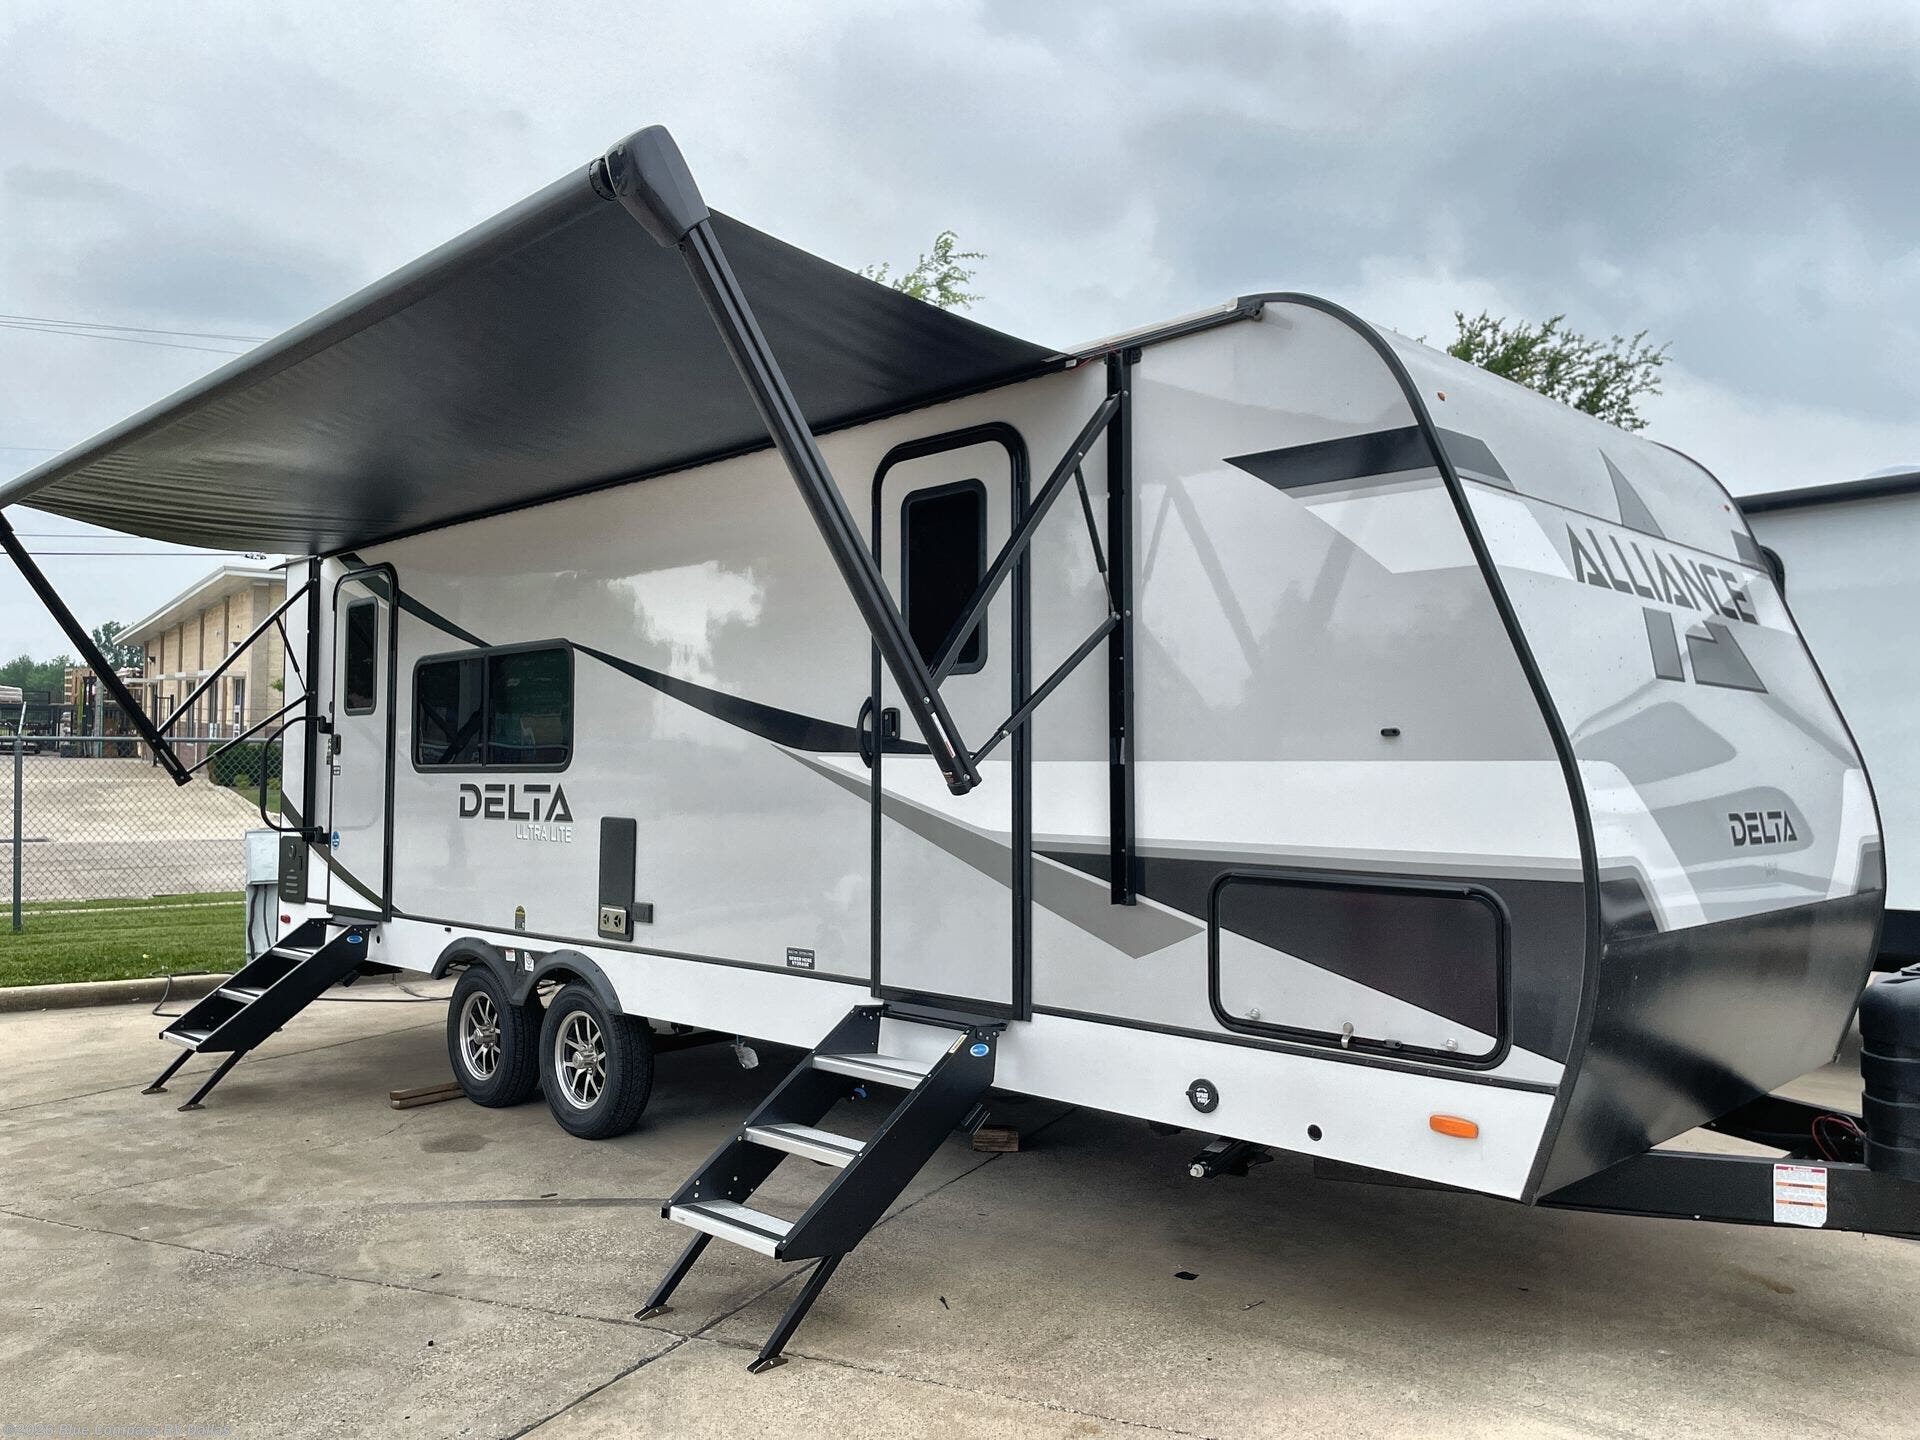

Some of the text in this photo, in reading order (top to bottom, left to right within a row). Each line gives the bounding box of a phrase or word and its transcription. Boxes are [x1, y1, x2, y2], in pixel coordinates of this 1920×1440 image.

[1565, 521, 1760, 625] ALLIANCE
[459, 782, 574, 822] DELTA
[515, 823, 573, 843] ULTRA LITE
[1727, 810, 1798, 847] DELTA
